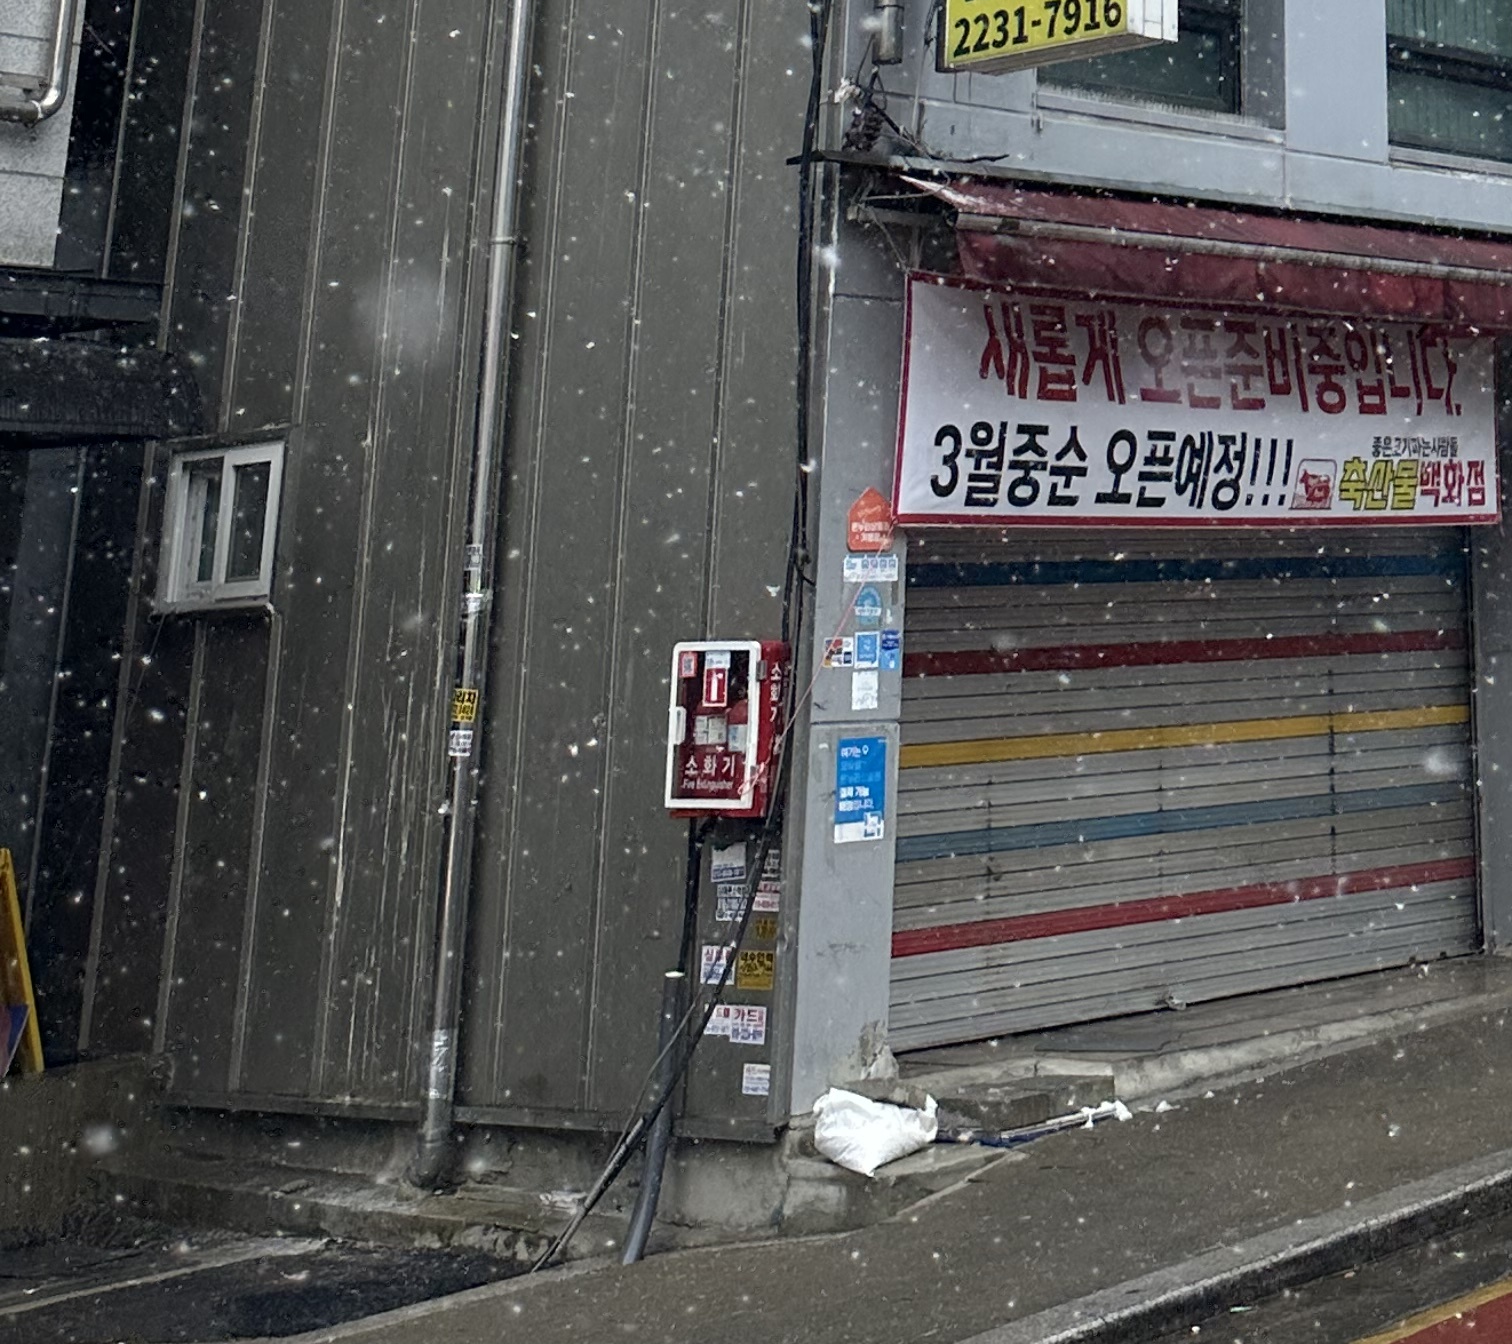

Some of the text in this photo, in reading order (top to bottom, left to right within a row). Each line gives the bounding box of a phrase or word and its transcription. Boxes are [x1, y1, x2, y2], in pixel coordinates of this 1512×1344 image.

[978, 303, 1126, 405] 새롭게
[931, 421, 1088, 508] 3월중순
[685, 754, 735, 777] 소화기
